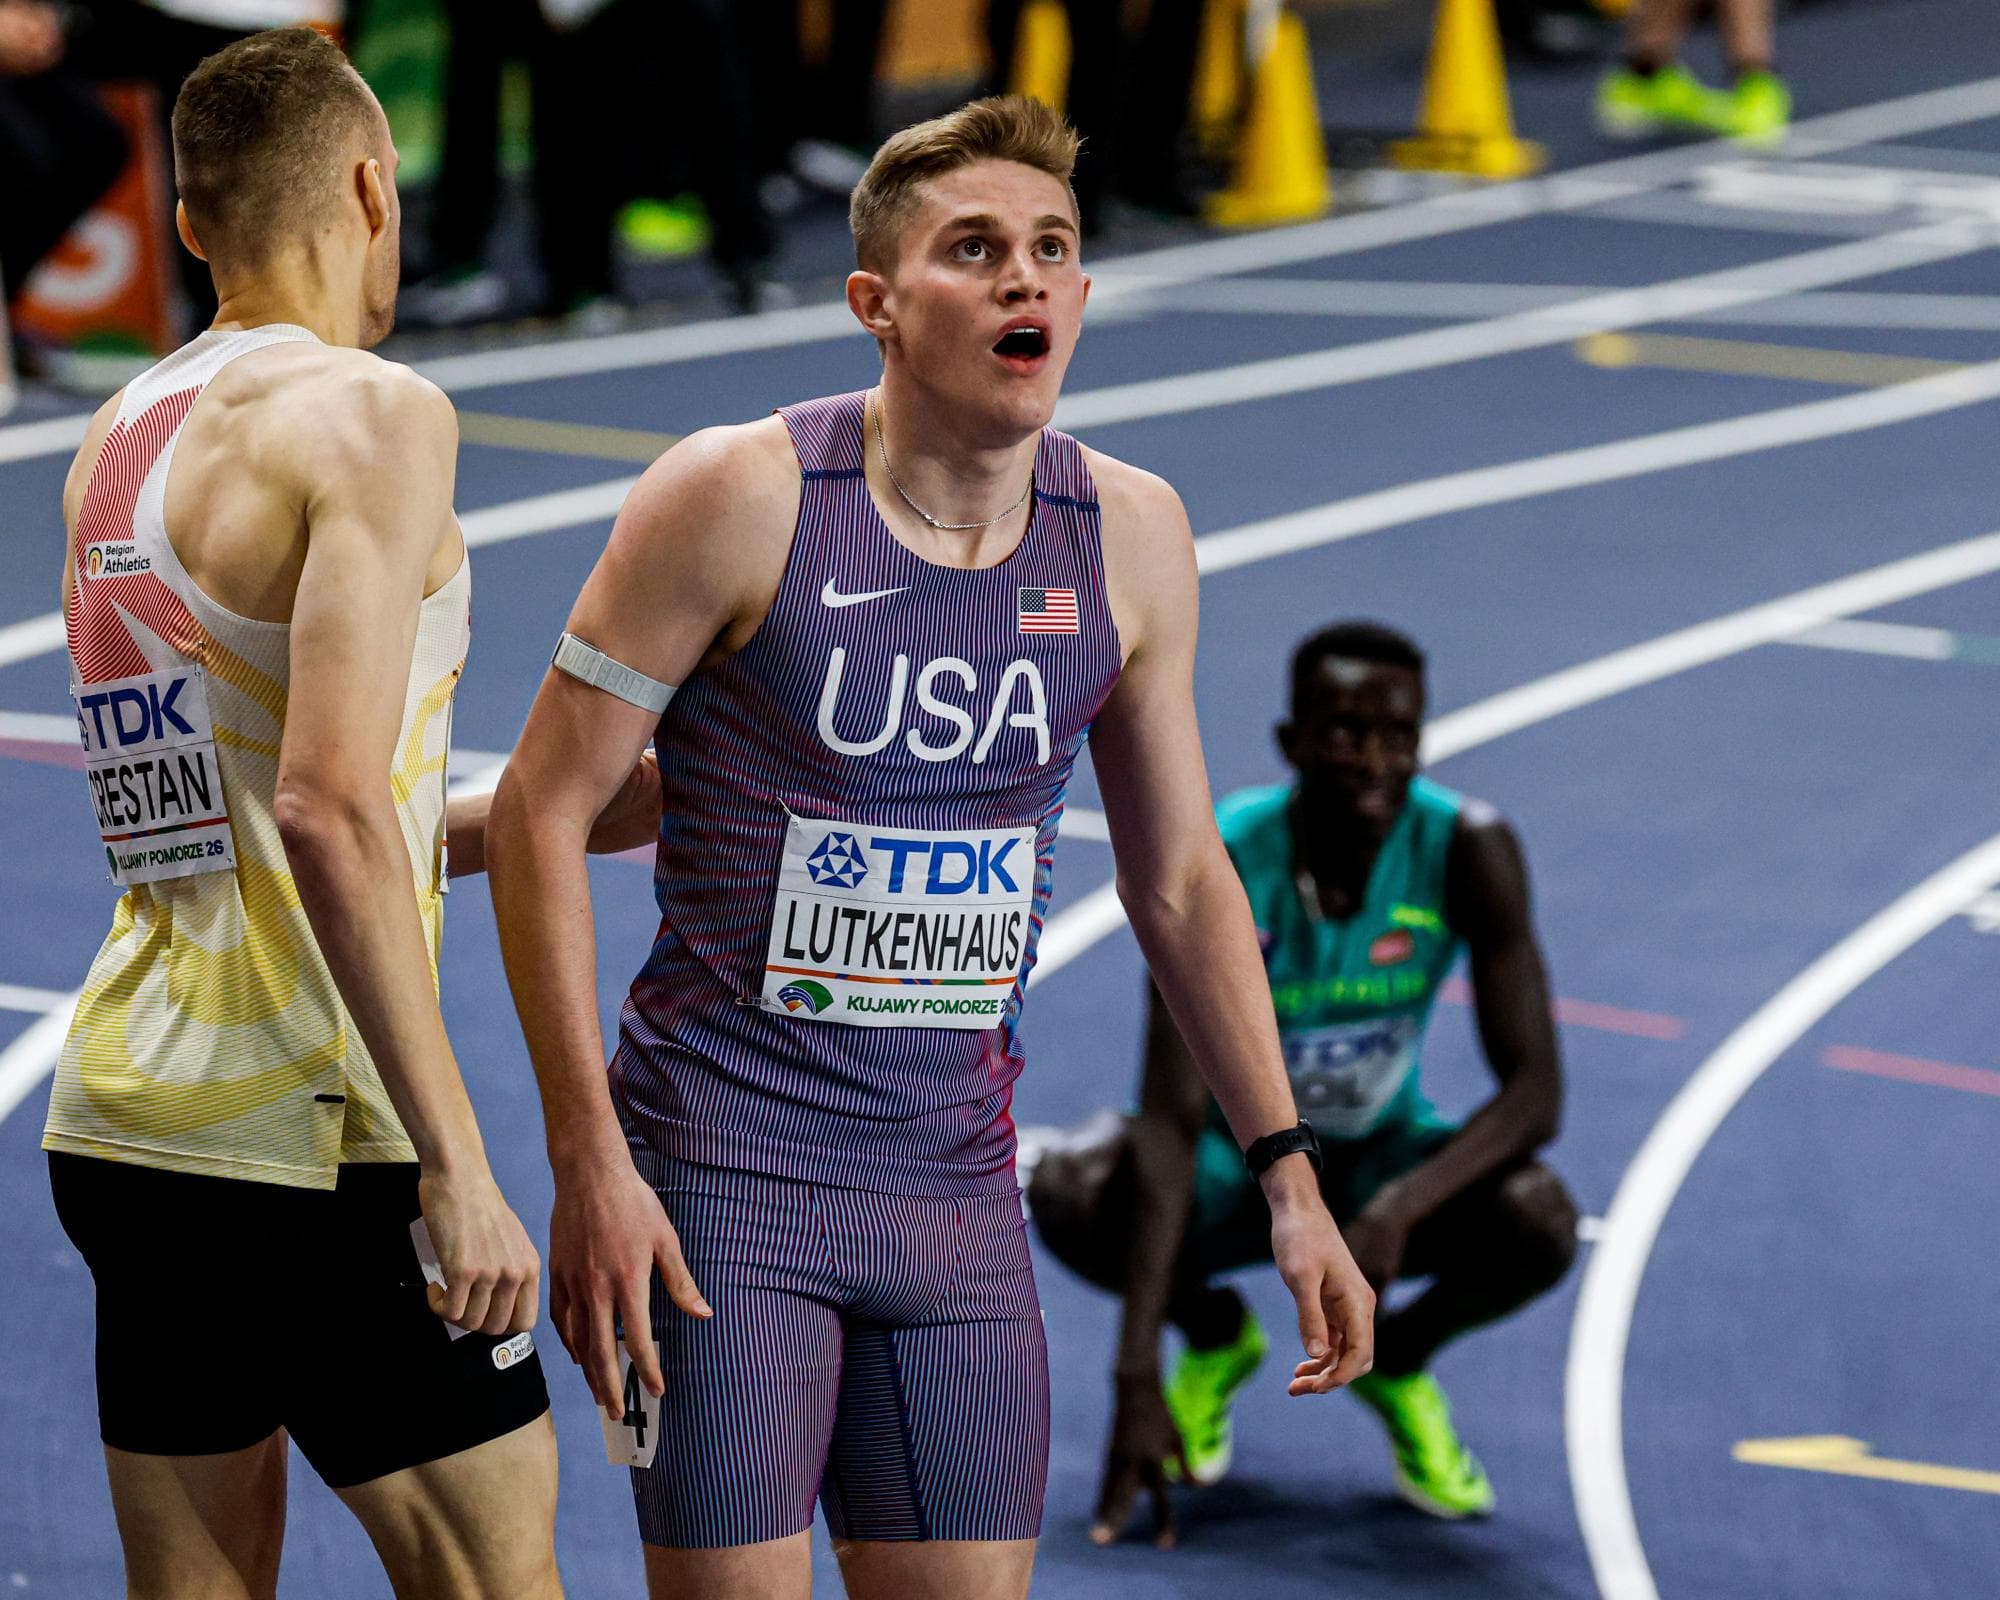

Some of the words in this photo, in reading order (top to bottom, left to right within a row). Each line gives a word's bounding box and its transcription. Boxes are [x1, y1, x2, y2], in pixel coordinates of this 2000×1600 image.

[103, 555, 151, 574] Athletics
[105, 545, 135, 556] Belgian
[80, 677, 196, 750] TDK
[817, 647, 1051, 766] USA
[148, 842, 205, 867] POMORZE
[205, 839, 225, 857] 26
[870, 837, 1021, 895] TDK
[783, 900, 1021, 972] LUTKENHAUS
[847, 995, 921, 1013] KUJAWY
[922, 999, 999, 1015] POMORZE
[623, 1361, 648, 1448] 4
